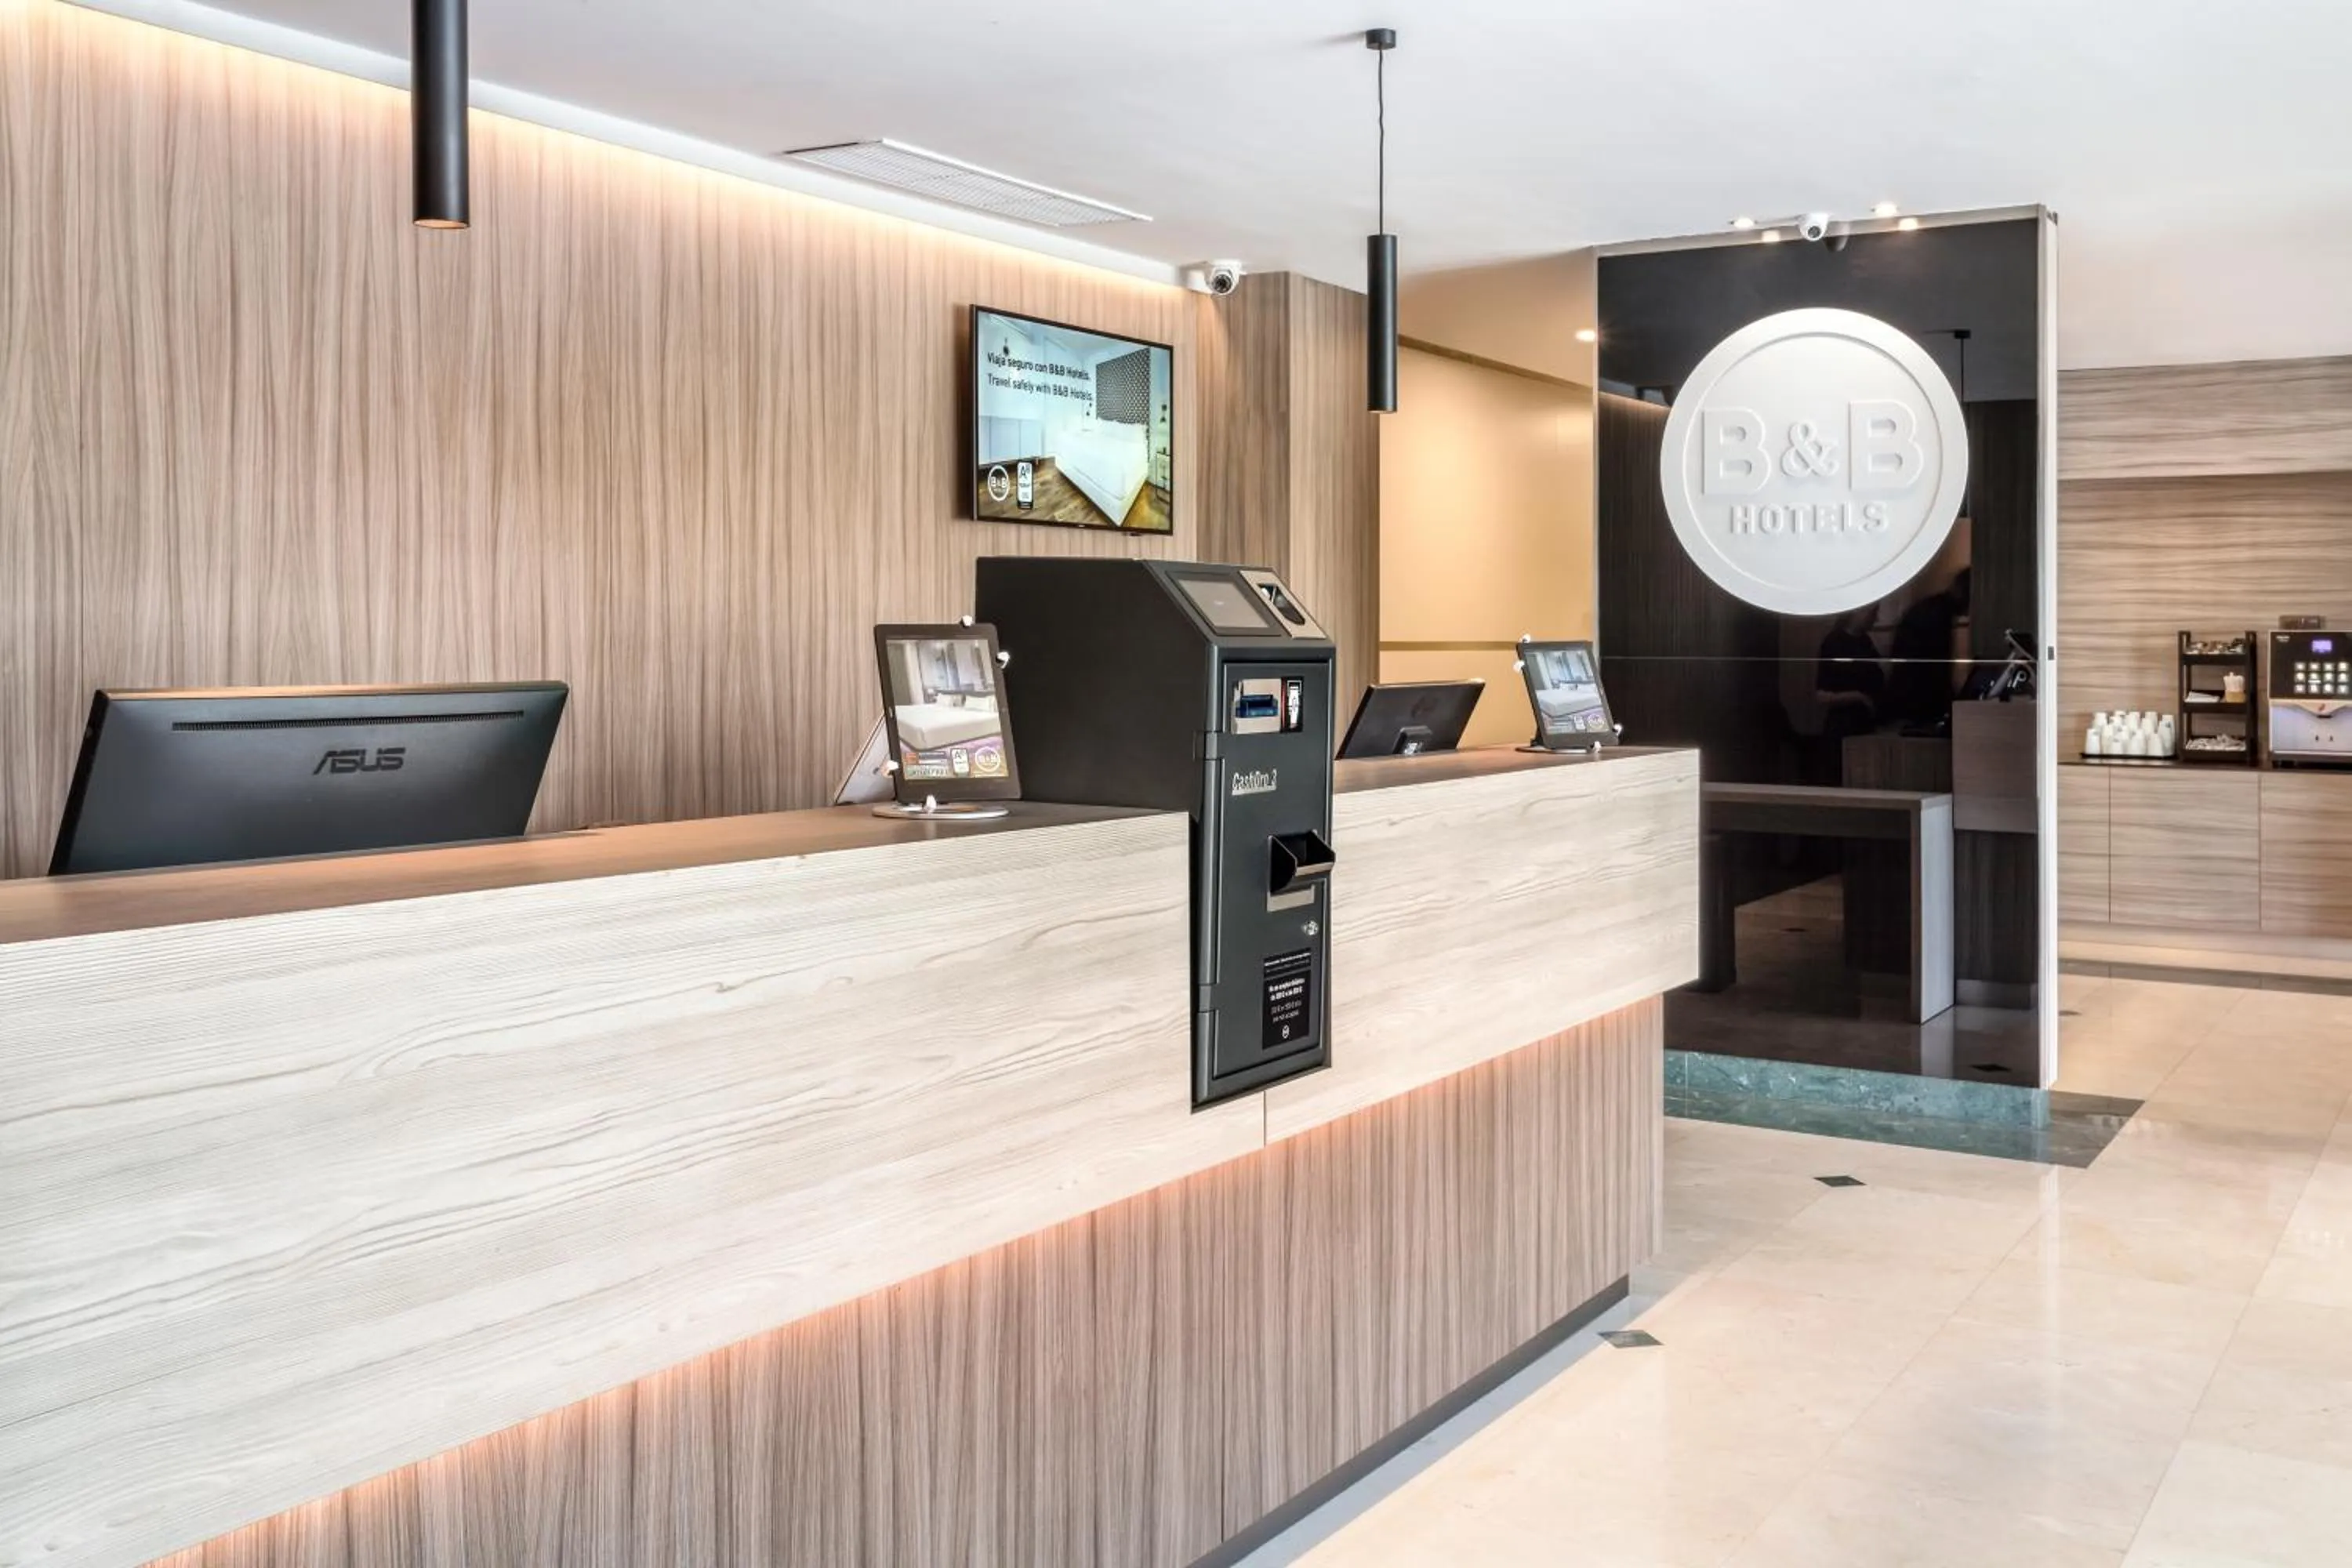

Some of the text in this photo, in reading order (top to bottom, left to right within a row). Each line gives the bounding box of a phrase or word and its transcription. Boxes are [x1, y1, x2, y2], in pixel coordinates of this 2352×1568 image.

[987, 352, 1006, 368] Viaja
[1007, 358, 1034, 371] seguro
[1035, 363, 1048, 372] con
[1049, 363, 1065, 376] B&B
[988, 372, 1011, 387] Travel
[1013, 379, 1034, 394] safely
[1036, 383, 1051, 394] with
[1701, 398, 1924, 495] B&B
[1729, 500, 1889, 535] HOTELS
[313, 747, 406, 775] ASUS
